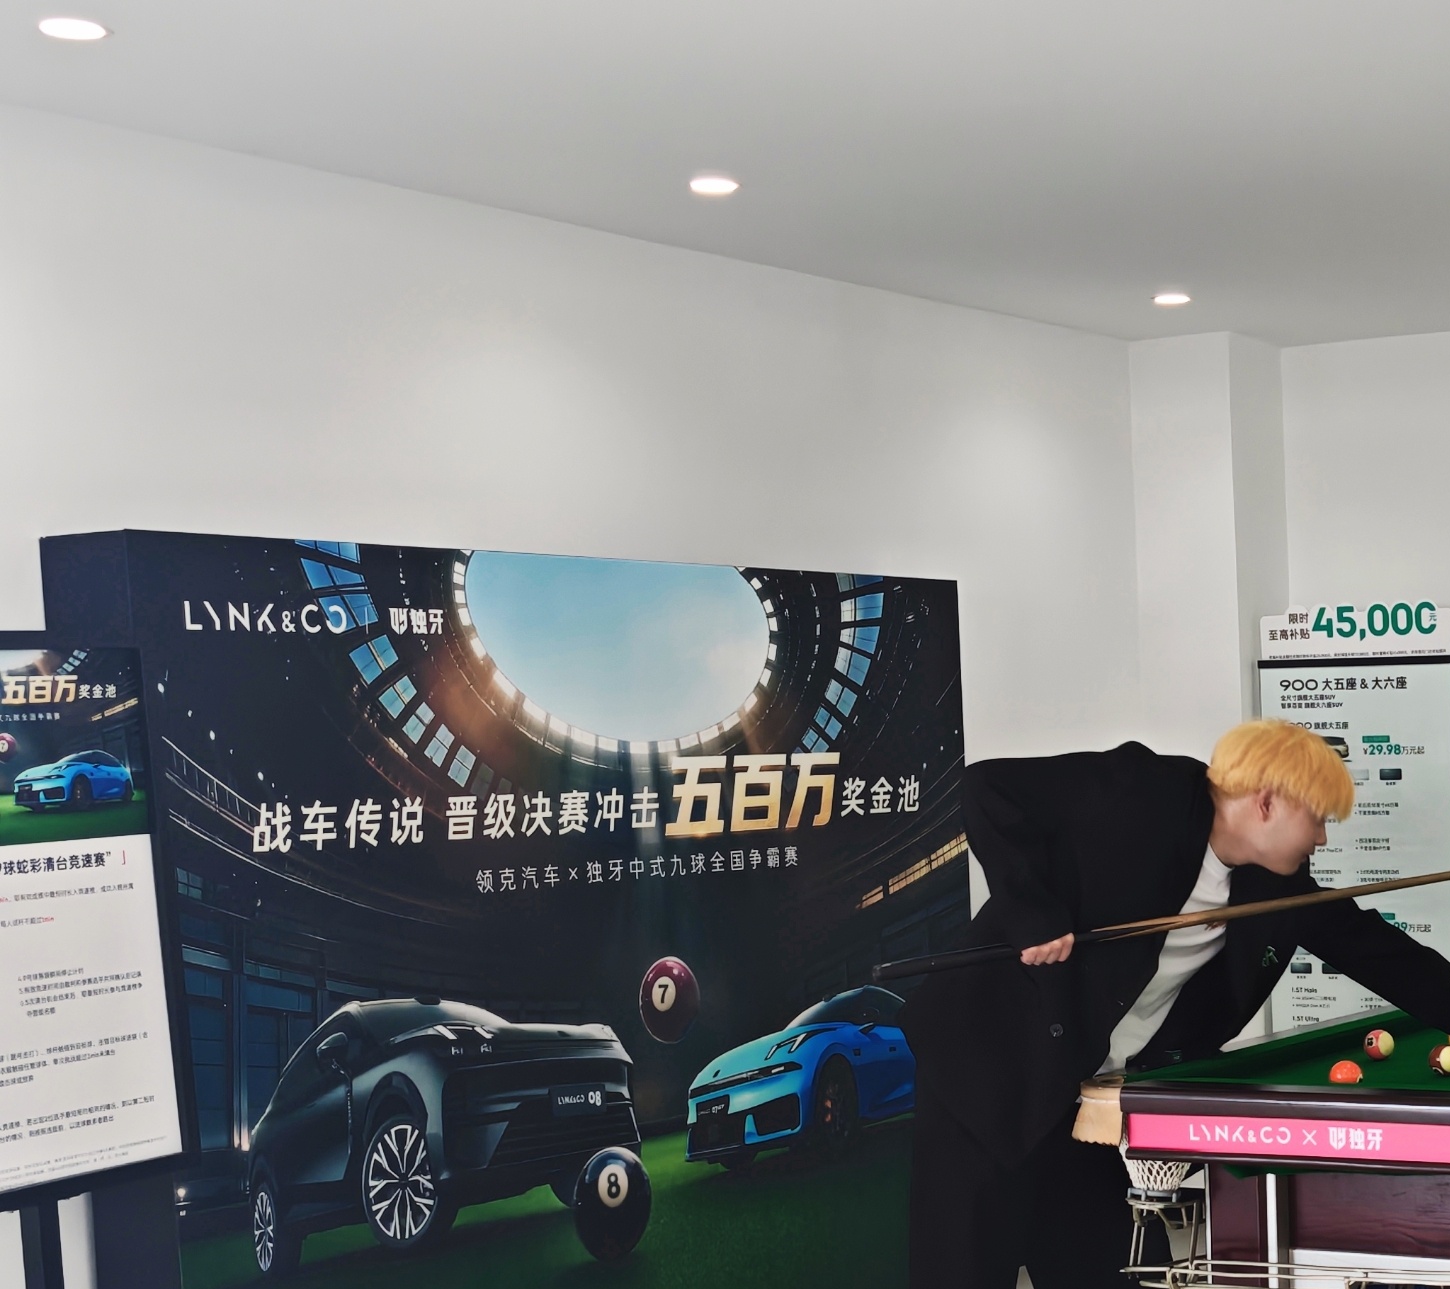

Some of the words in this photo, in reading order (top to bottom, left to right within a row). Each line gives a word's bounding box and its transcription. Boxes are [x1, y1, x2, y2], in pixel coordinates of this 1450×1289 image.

[183, 600, 347, 634] LYNK&CO
[1288, 612, 1309, 624] 限时
[1268, 628, 1311, 641] 至高补贴
[1279, 679, 1318, 691] 900
[1321, 677, 1357, 691] 大五座
[1360, 678, 1369, 689] &
[1371, 676, 1407, 690] 大六座
[252, 796, 424, 853] 战车传说
[0, 851, 111, 876] 球蛇彩清台竞速赛”
[658, 984, 669, 1004] 7
[588, 1091, 602, 1106] 08
[1189, 1124, 1291, 1145] LYNK&CO
[607, 1173, 621, 1198] 8
